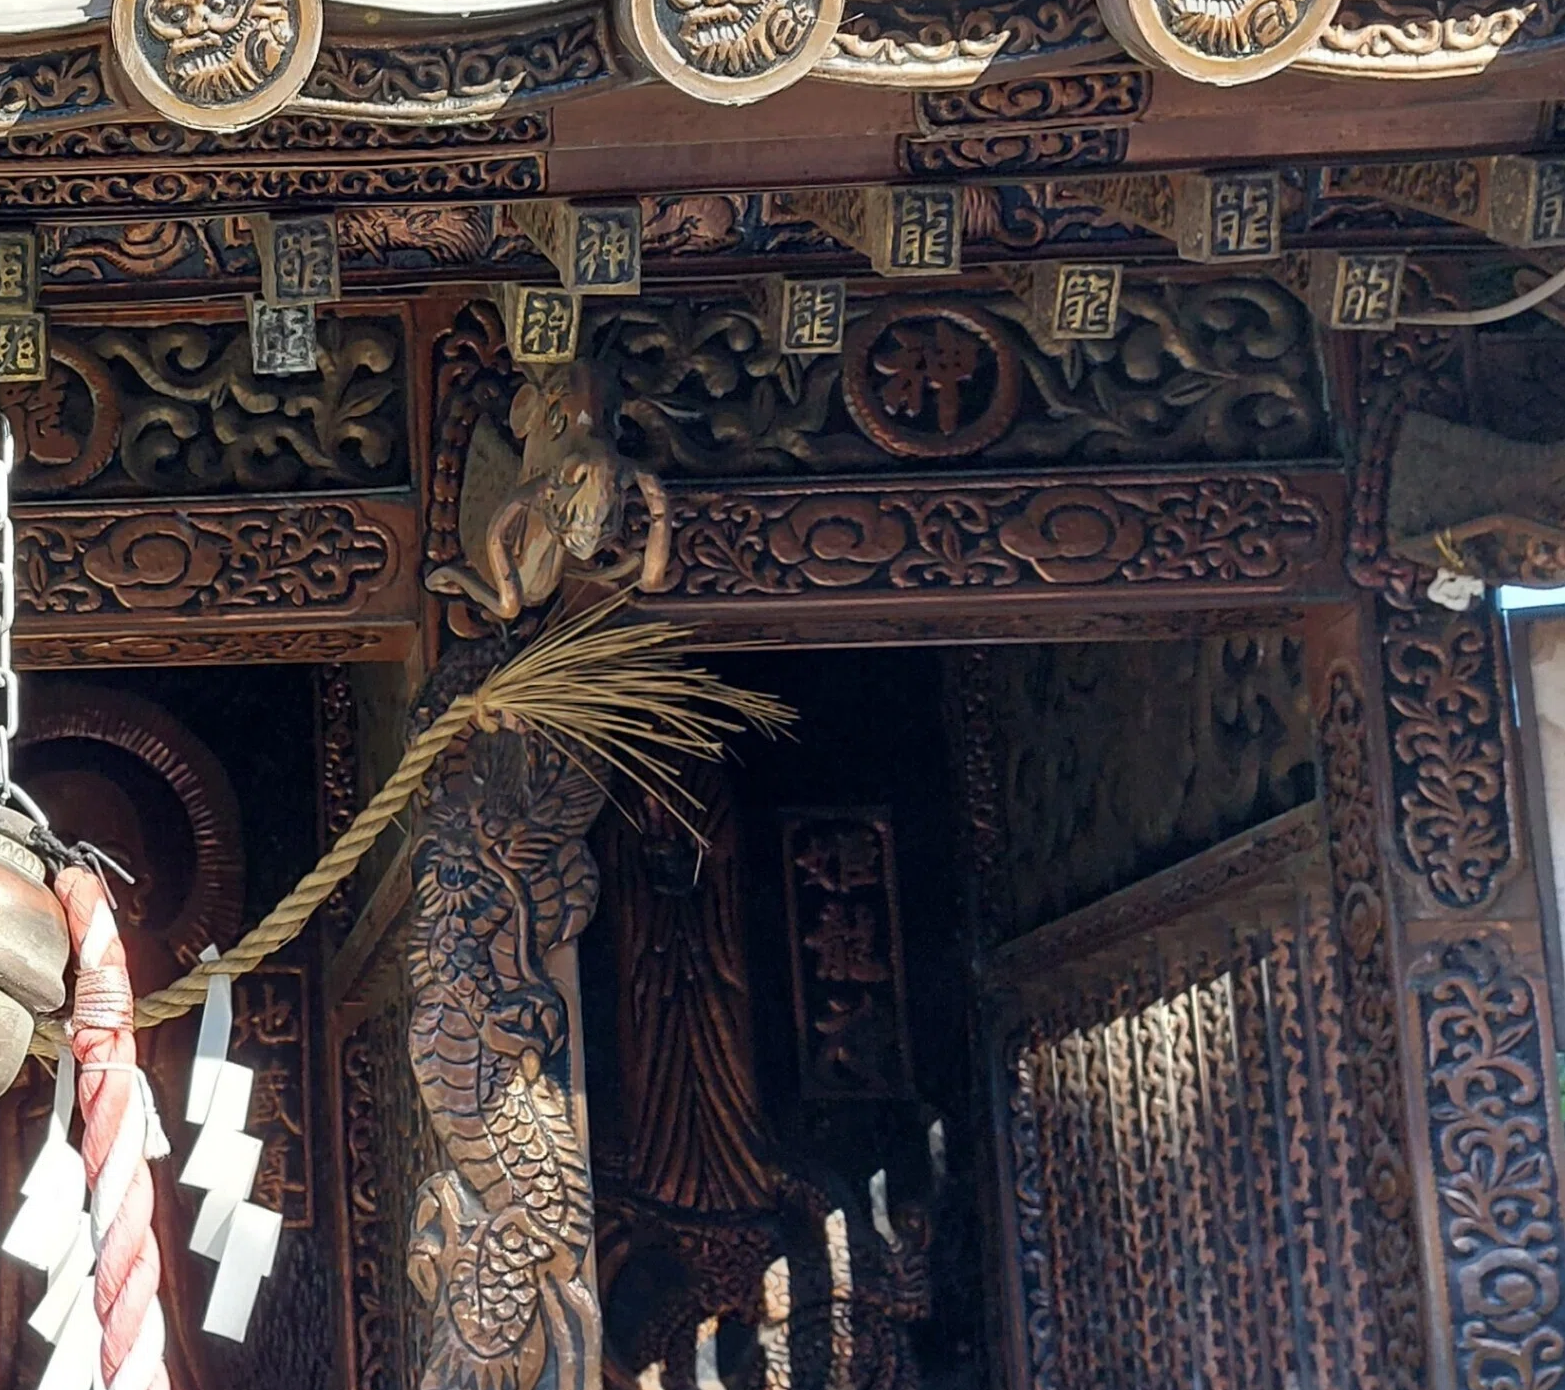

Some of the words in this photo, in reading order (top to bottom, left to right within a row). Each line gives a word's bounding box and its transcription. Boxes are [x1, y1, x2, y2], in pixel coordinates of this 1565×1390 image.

[579, 216, 631, 281] 神
[901, 194, 950, 265] 龍
[1217, 183, 1268, 251] 龍
[279, 229, 330, 295] 龍
[1342, 262, 1391, 320] 龍
[791, 285, 836, 344] 龍
[1063, 271, 1110, 332] 龍
[874, 322, 980, 436] 神
